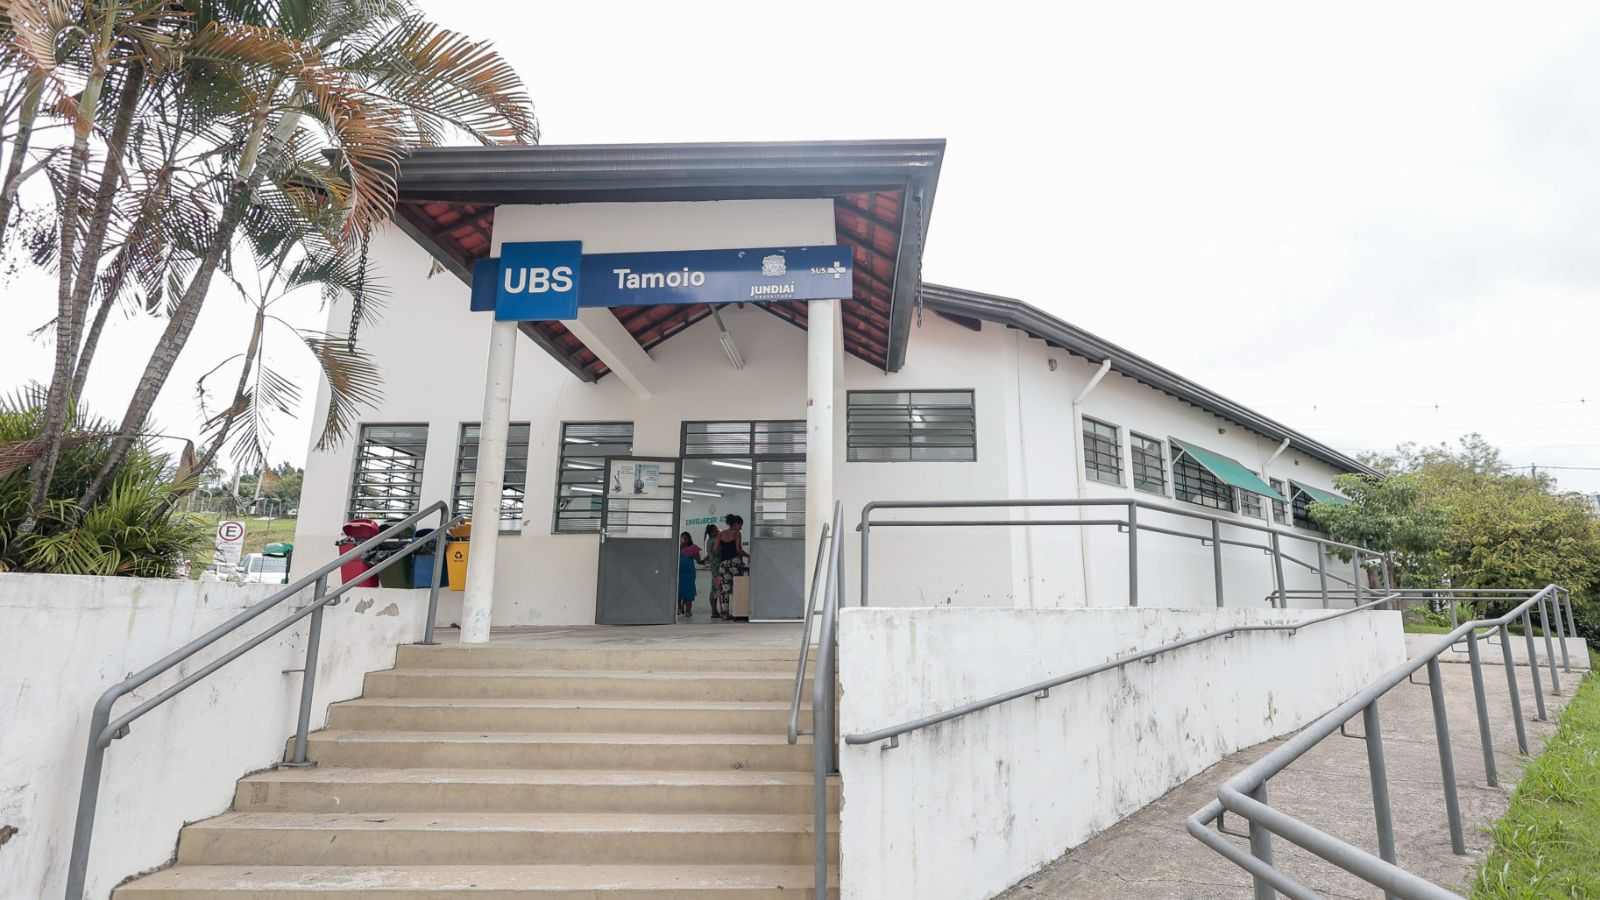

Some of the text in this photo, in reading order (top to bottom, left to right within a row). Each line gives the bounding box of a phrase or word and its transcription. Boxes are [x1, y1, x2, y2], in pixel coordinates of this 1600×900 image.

[504, 266, 573, 293] UBS
[613, 267, 705, 289] Tamoio
[226, 526, 237, 537] E
